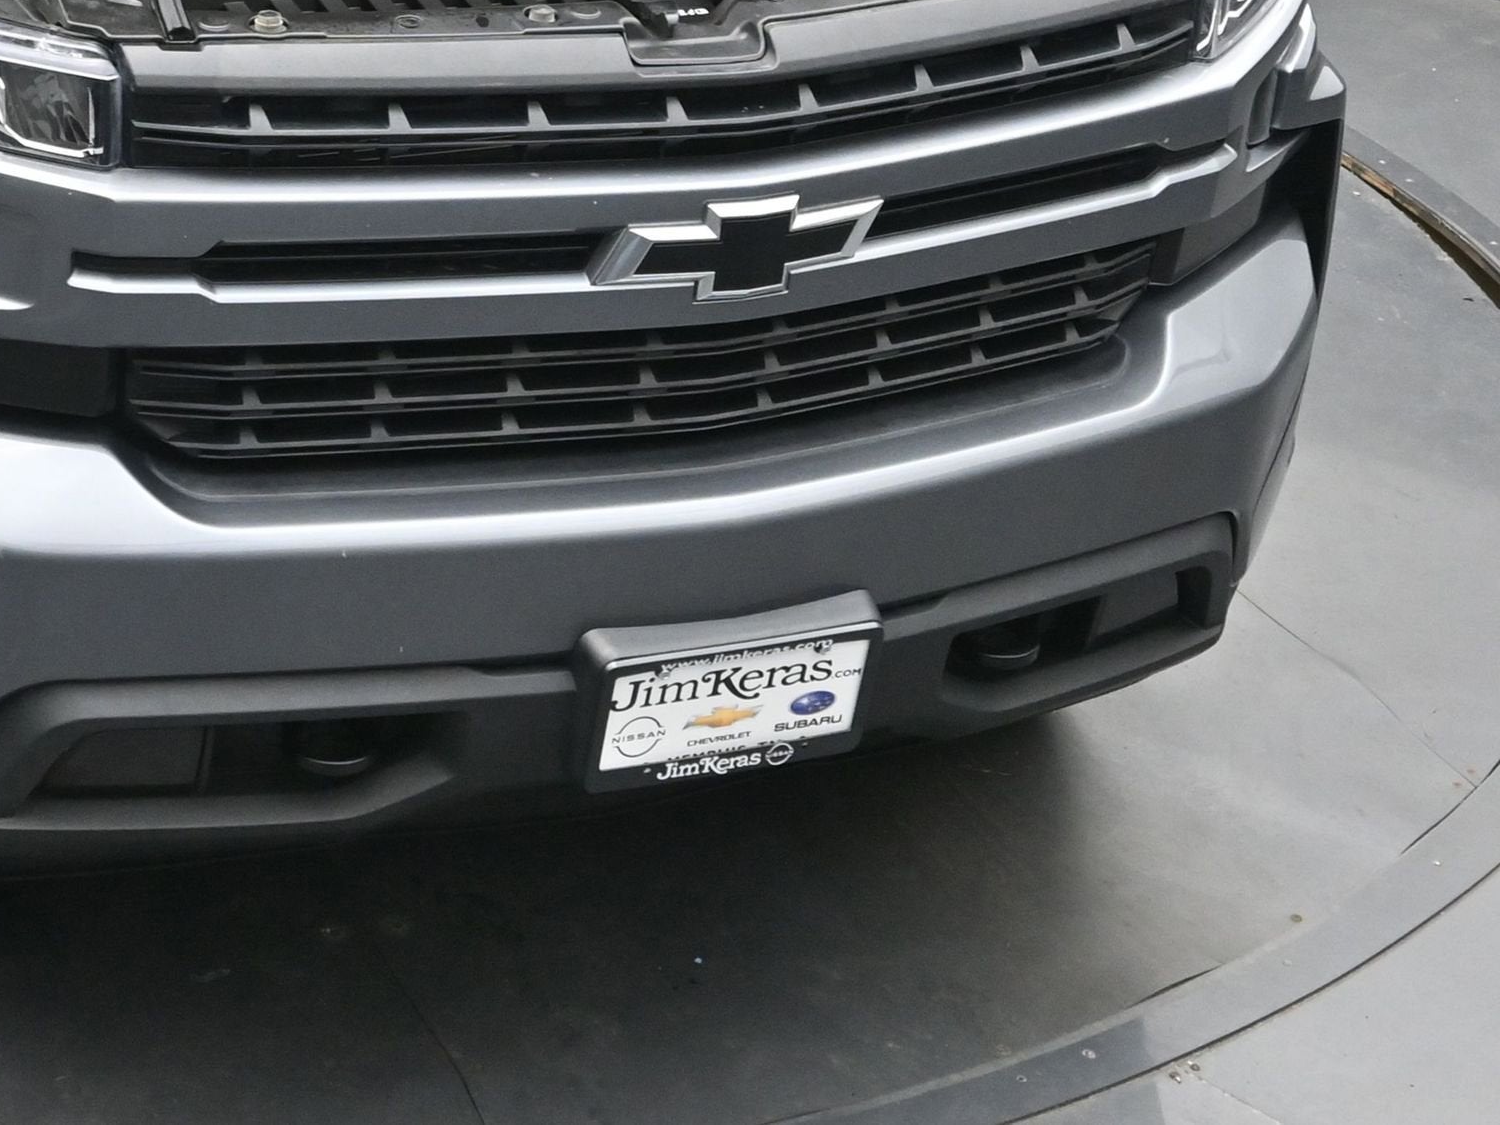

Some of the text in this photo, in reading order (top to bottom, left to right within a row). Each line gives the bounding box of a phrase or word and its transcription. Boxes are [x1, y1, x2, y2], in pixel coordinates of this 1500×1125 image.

[774, 714, 842, 732] SUBARU
[611, 728, 666, 745] NISSAN
[687, 730, 752, 747] CHEVROLET
